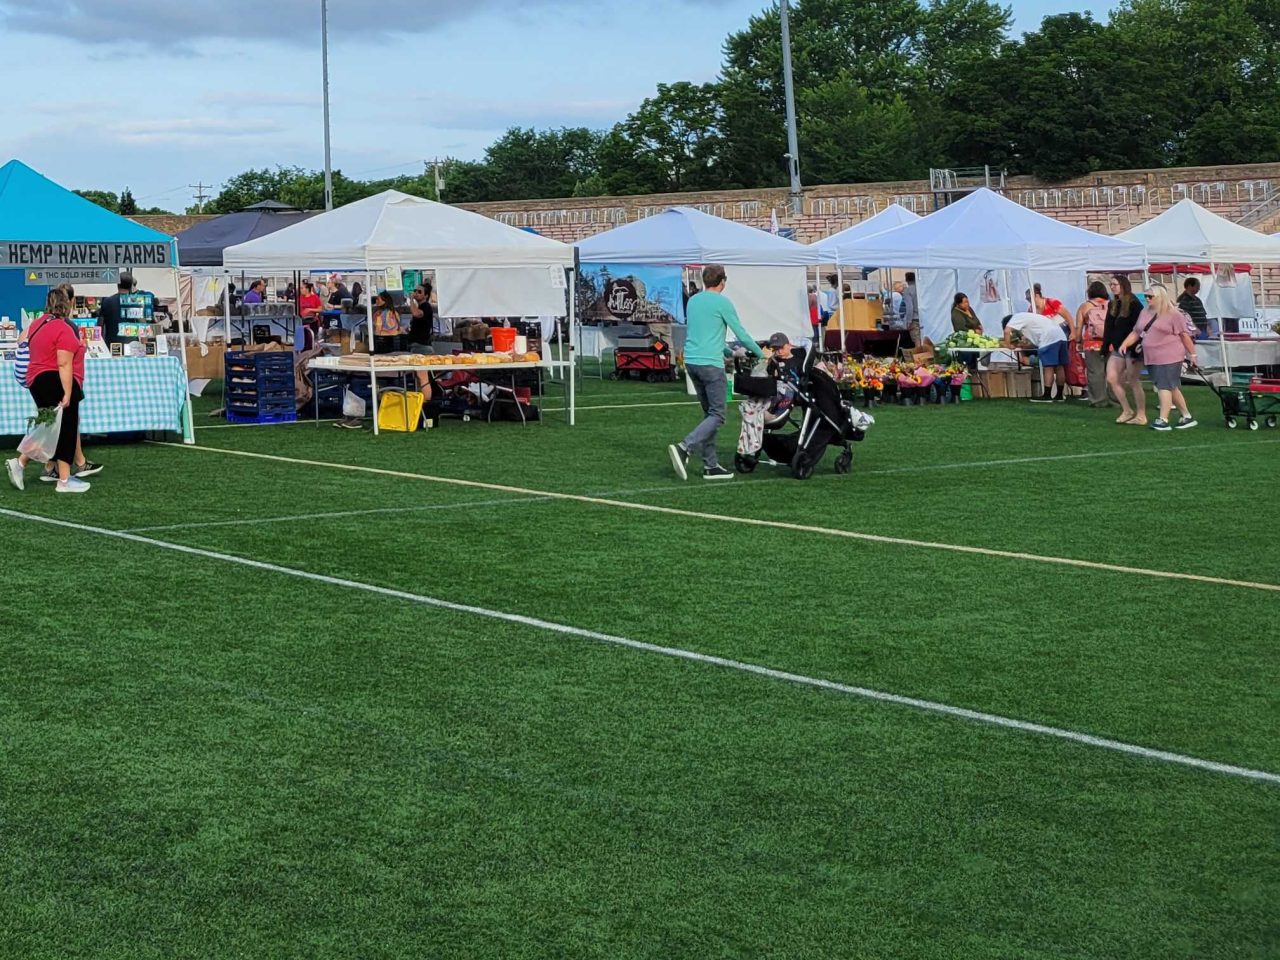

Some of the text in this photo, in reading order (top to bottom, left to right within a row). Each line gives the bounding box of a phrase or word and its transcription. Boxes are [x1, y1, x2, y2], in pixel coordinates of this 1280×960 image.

[8, 243, 166, 265] HEMP HAVEN FARMS
[45, 272, 59, 280] THC
[60, 271, 79, 280] SOLD
[81, 270, 100, 279] HERE
